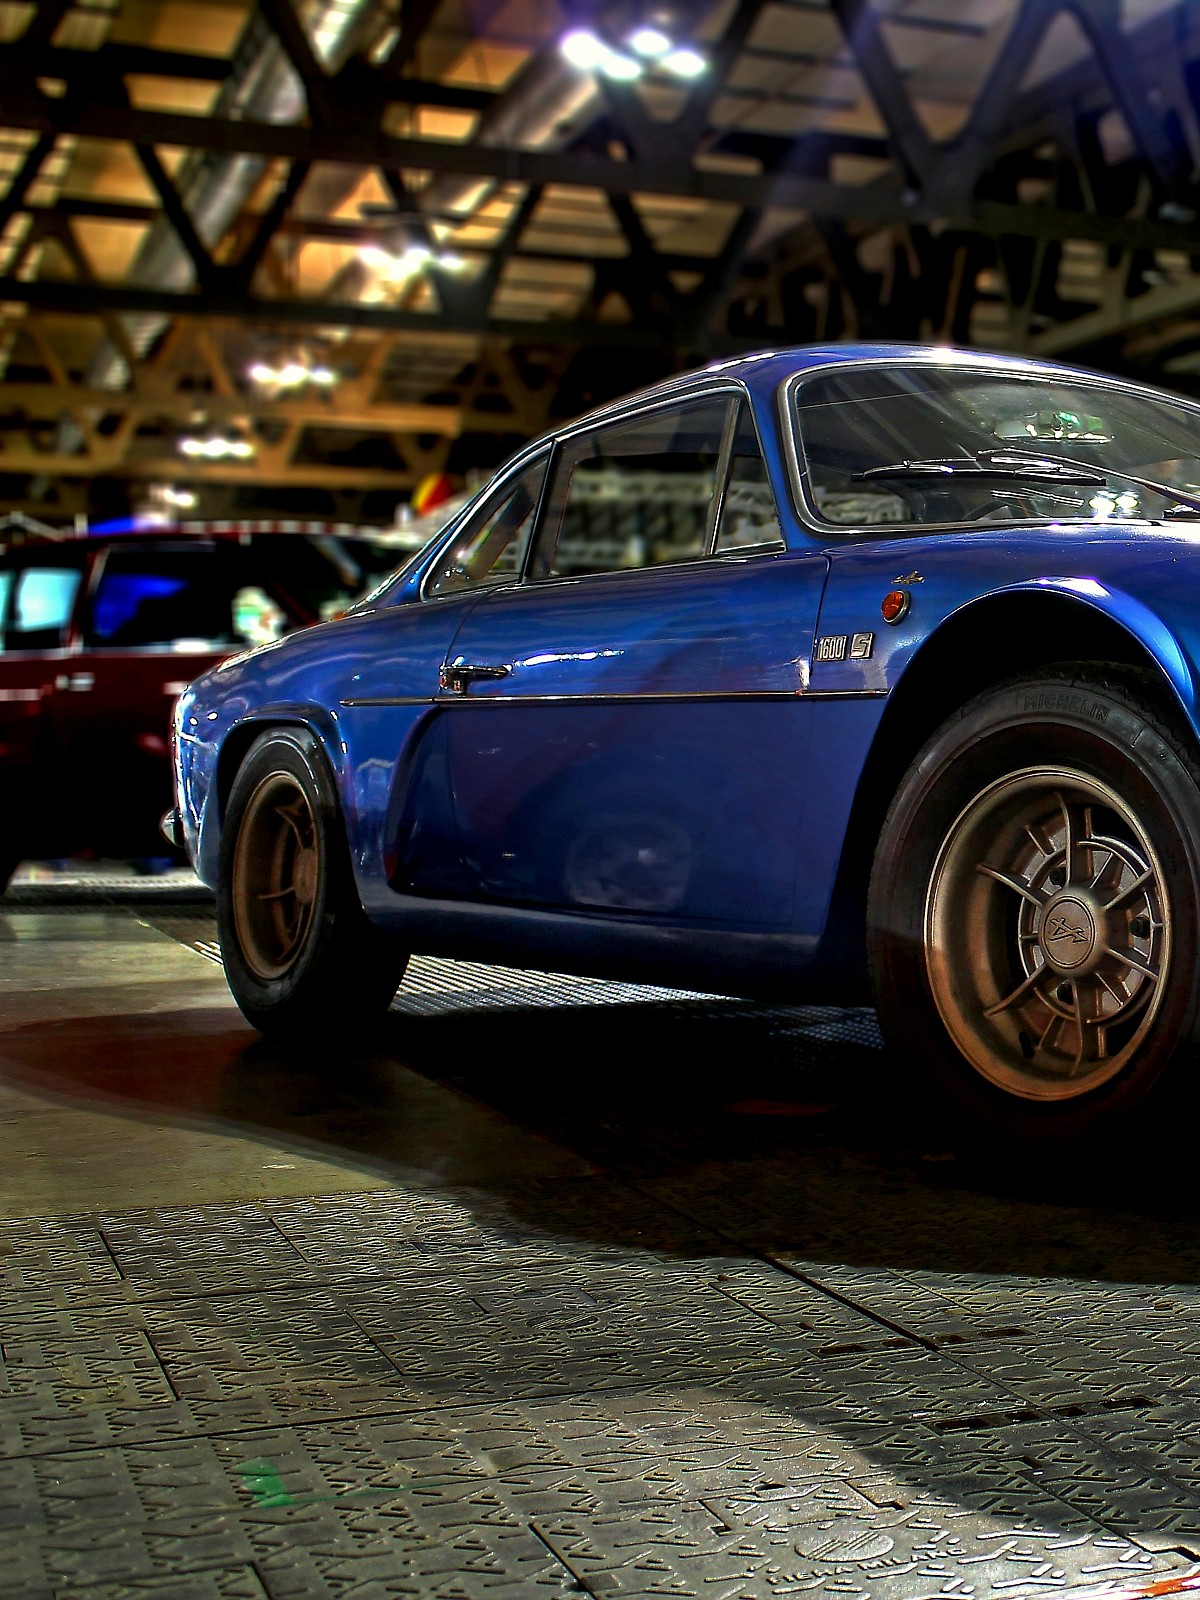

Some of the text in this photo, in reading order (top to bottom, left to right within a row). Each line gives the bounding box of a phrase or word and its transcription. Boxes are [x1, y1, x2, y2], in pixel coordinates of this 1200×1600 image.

[818, 633, 872, 660] 1600 S
[1023, 694, 1111, 724] MICHELIN
[857, 1547, 968, 1571] MILANO
